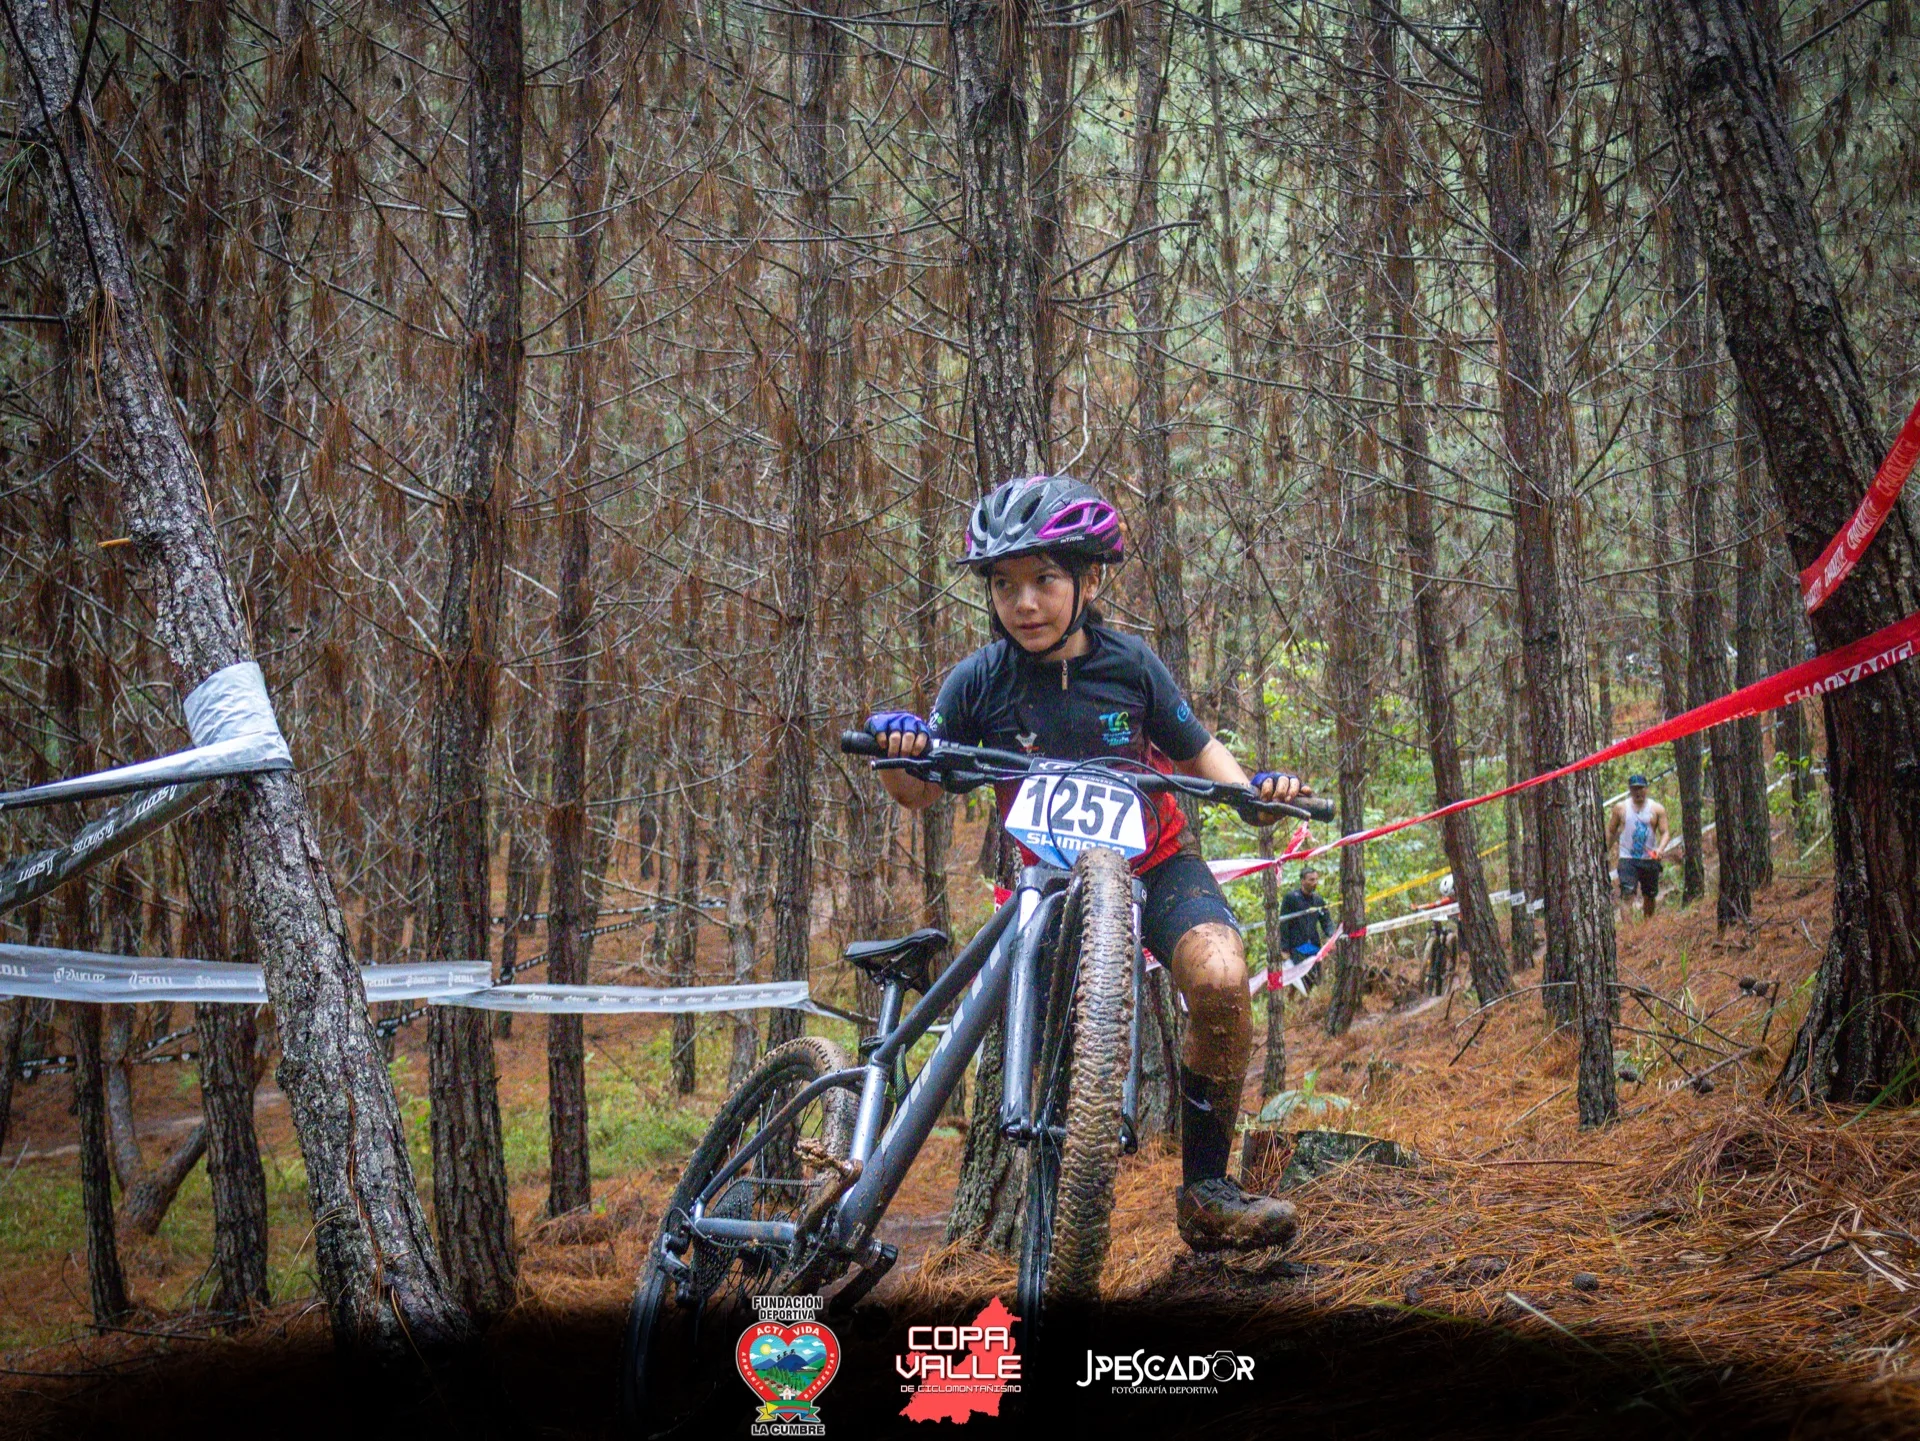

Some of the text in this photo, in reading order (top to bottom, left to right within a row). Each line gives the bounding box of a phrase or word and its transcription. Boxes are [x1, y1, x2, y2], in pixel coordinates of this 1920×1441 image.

[1783, 640, 1914, 704] CHAOYANG
[134, 786, 170, 818] SCOTT
[1026, 776, 1135, 840] 1257
[17, 861, 47, 883] SCOTT
